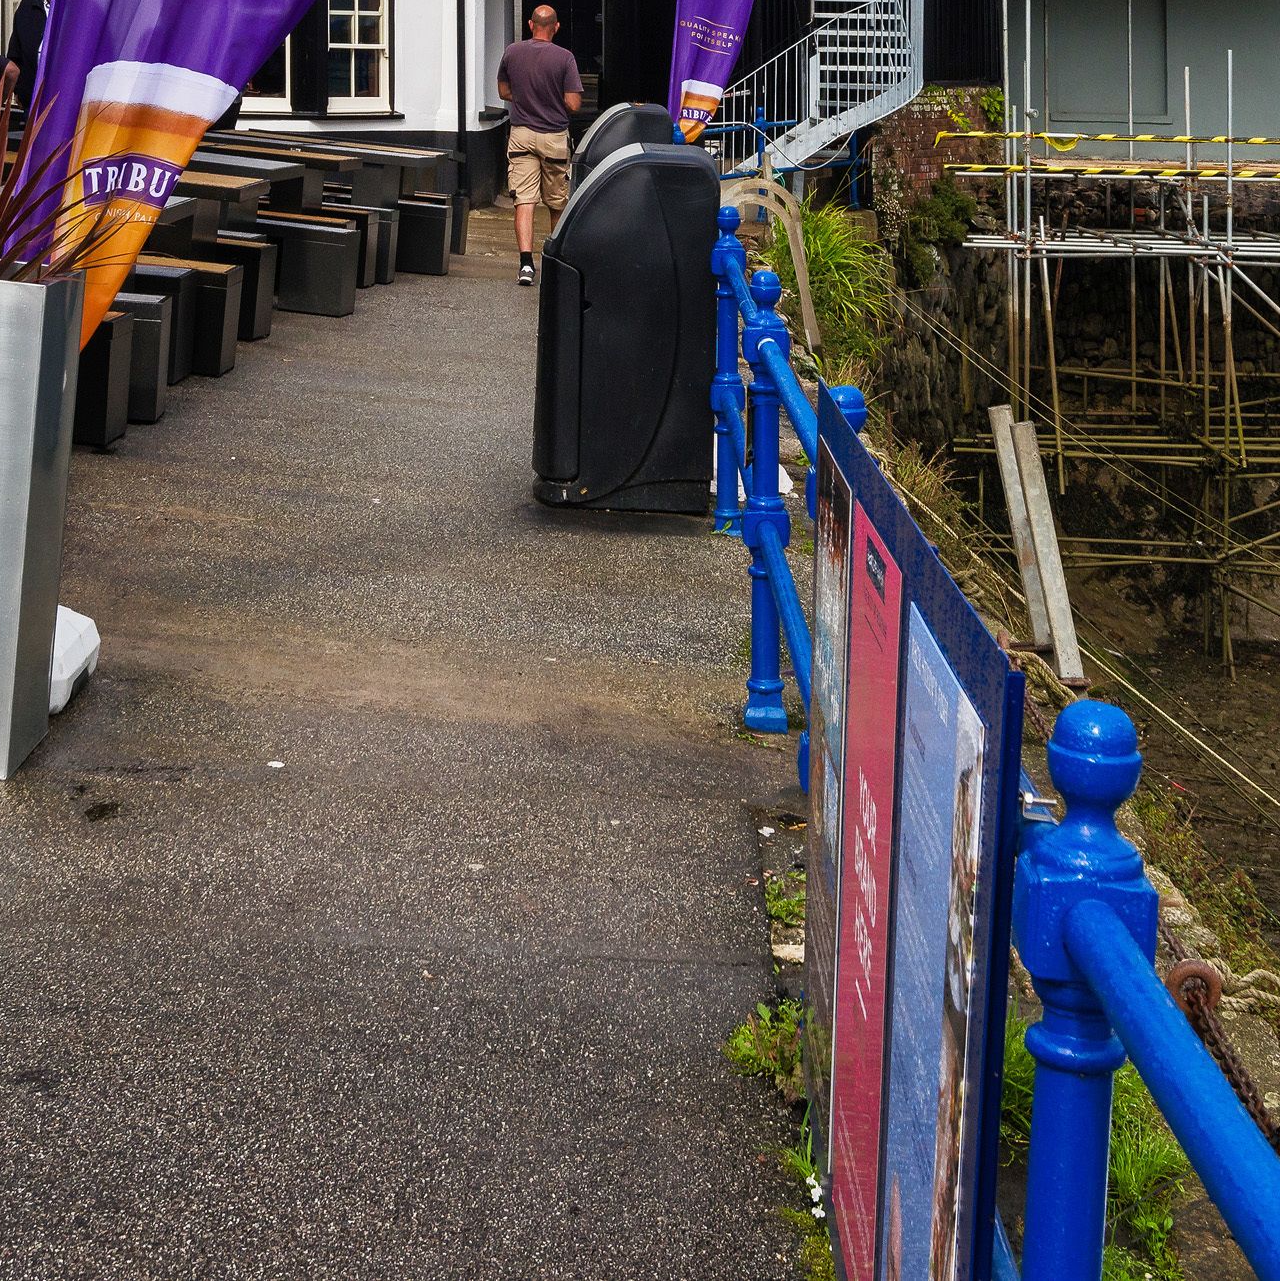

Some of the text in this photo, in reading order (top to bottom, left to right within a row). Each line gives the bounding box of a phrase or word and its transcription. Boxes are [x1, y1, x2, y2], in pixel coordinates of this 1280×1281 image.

[680, 20, 741, 43] QUALITY SPEAK
[704, 37, 732, 48] ITSELF
